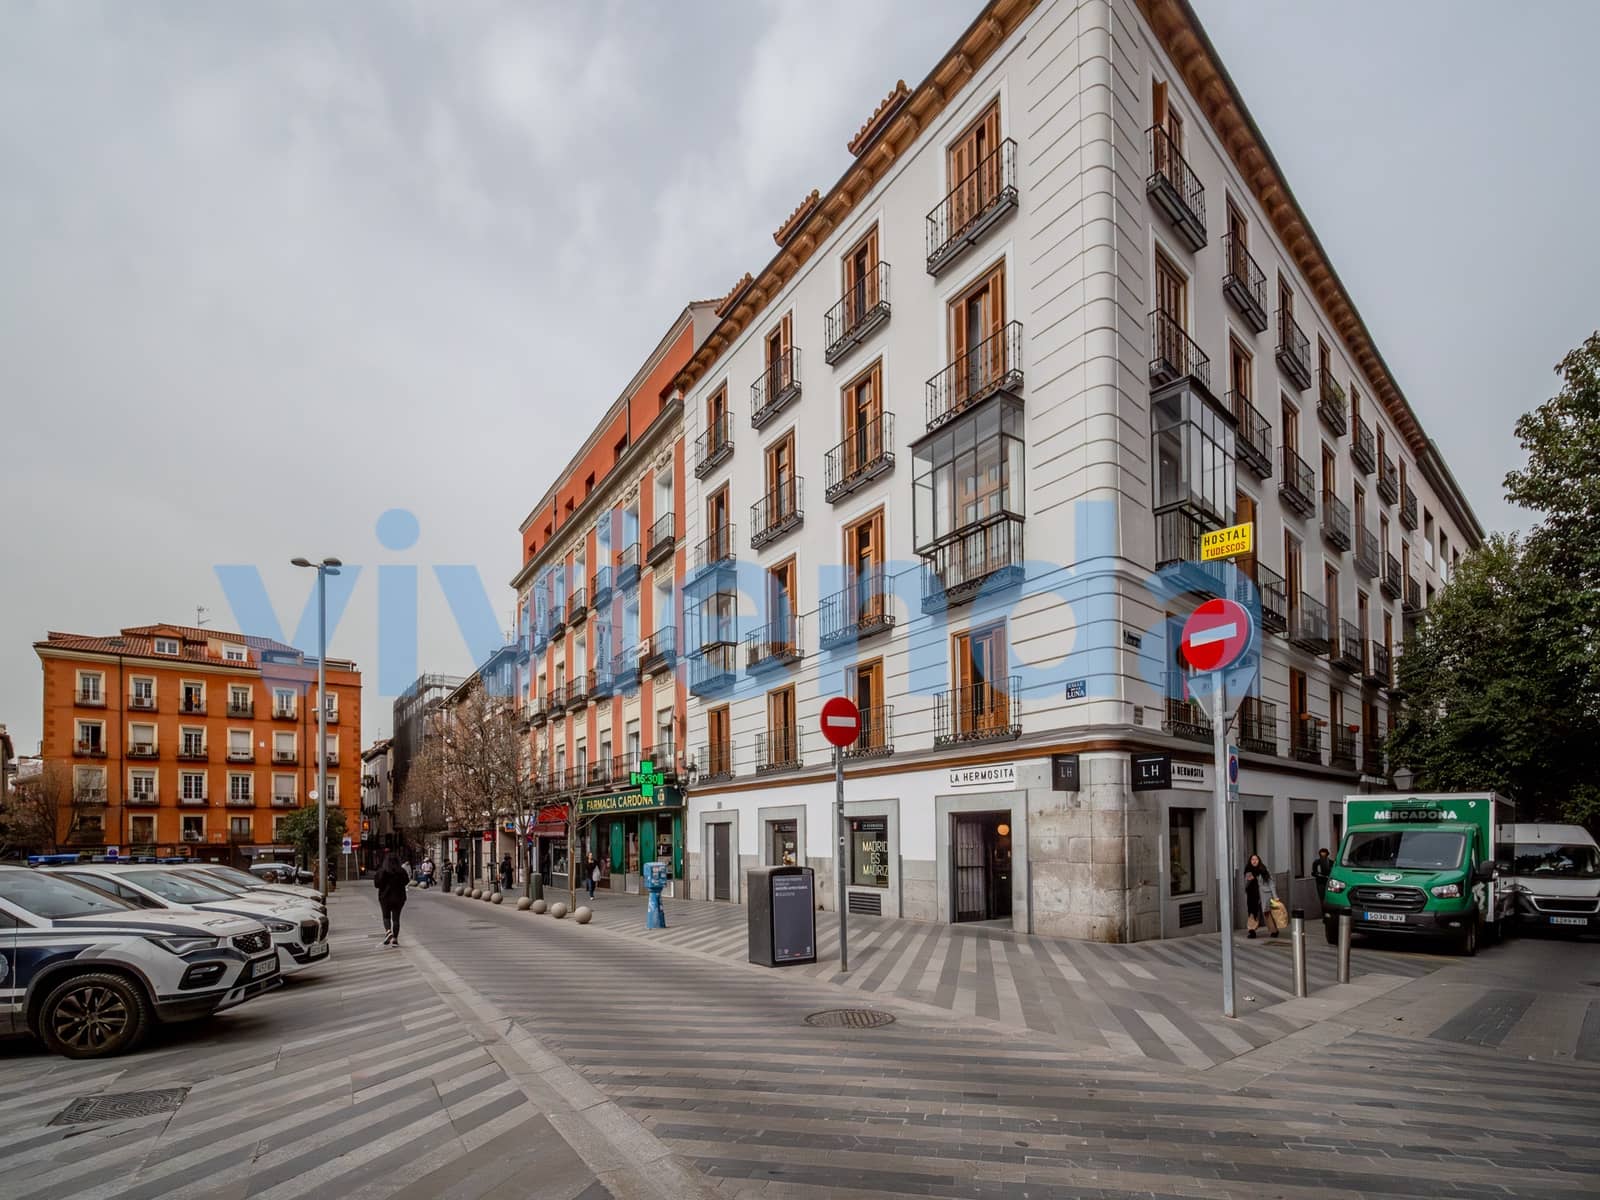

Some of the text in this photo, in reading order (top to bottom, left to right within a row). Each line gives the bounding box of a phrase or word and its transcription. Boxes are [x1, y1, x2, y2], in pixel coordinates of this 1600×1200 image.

[1204, 527, 1247, 547] HOSTAL
[1205, 541, 1246, 558] TUDESCOS
[950, 768, 1014, 784] LA HERMOSITA
[1061, 766, 1072, 778] LH
[1142, 764, 1159, 777] LH
[636, 774, 658, 784] 15:30
[586, 794, 653, 811] FARMACIA CARDONA
[1468, 800, 1476, 808] 9
[1374, 810, 1457, 820] MERCADONA
[862, 840, 888, 852] MADRID
[871, 852, 880, 864] ES
